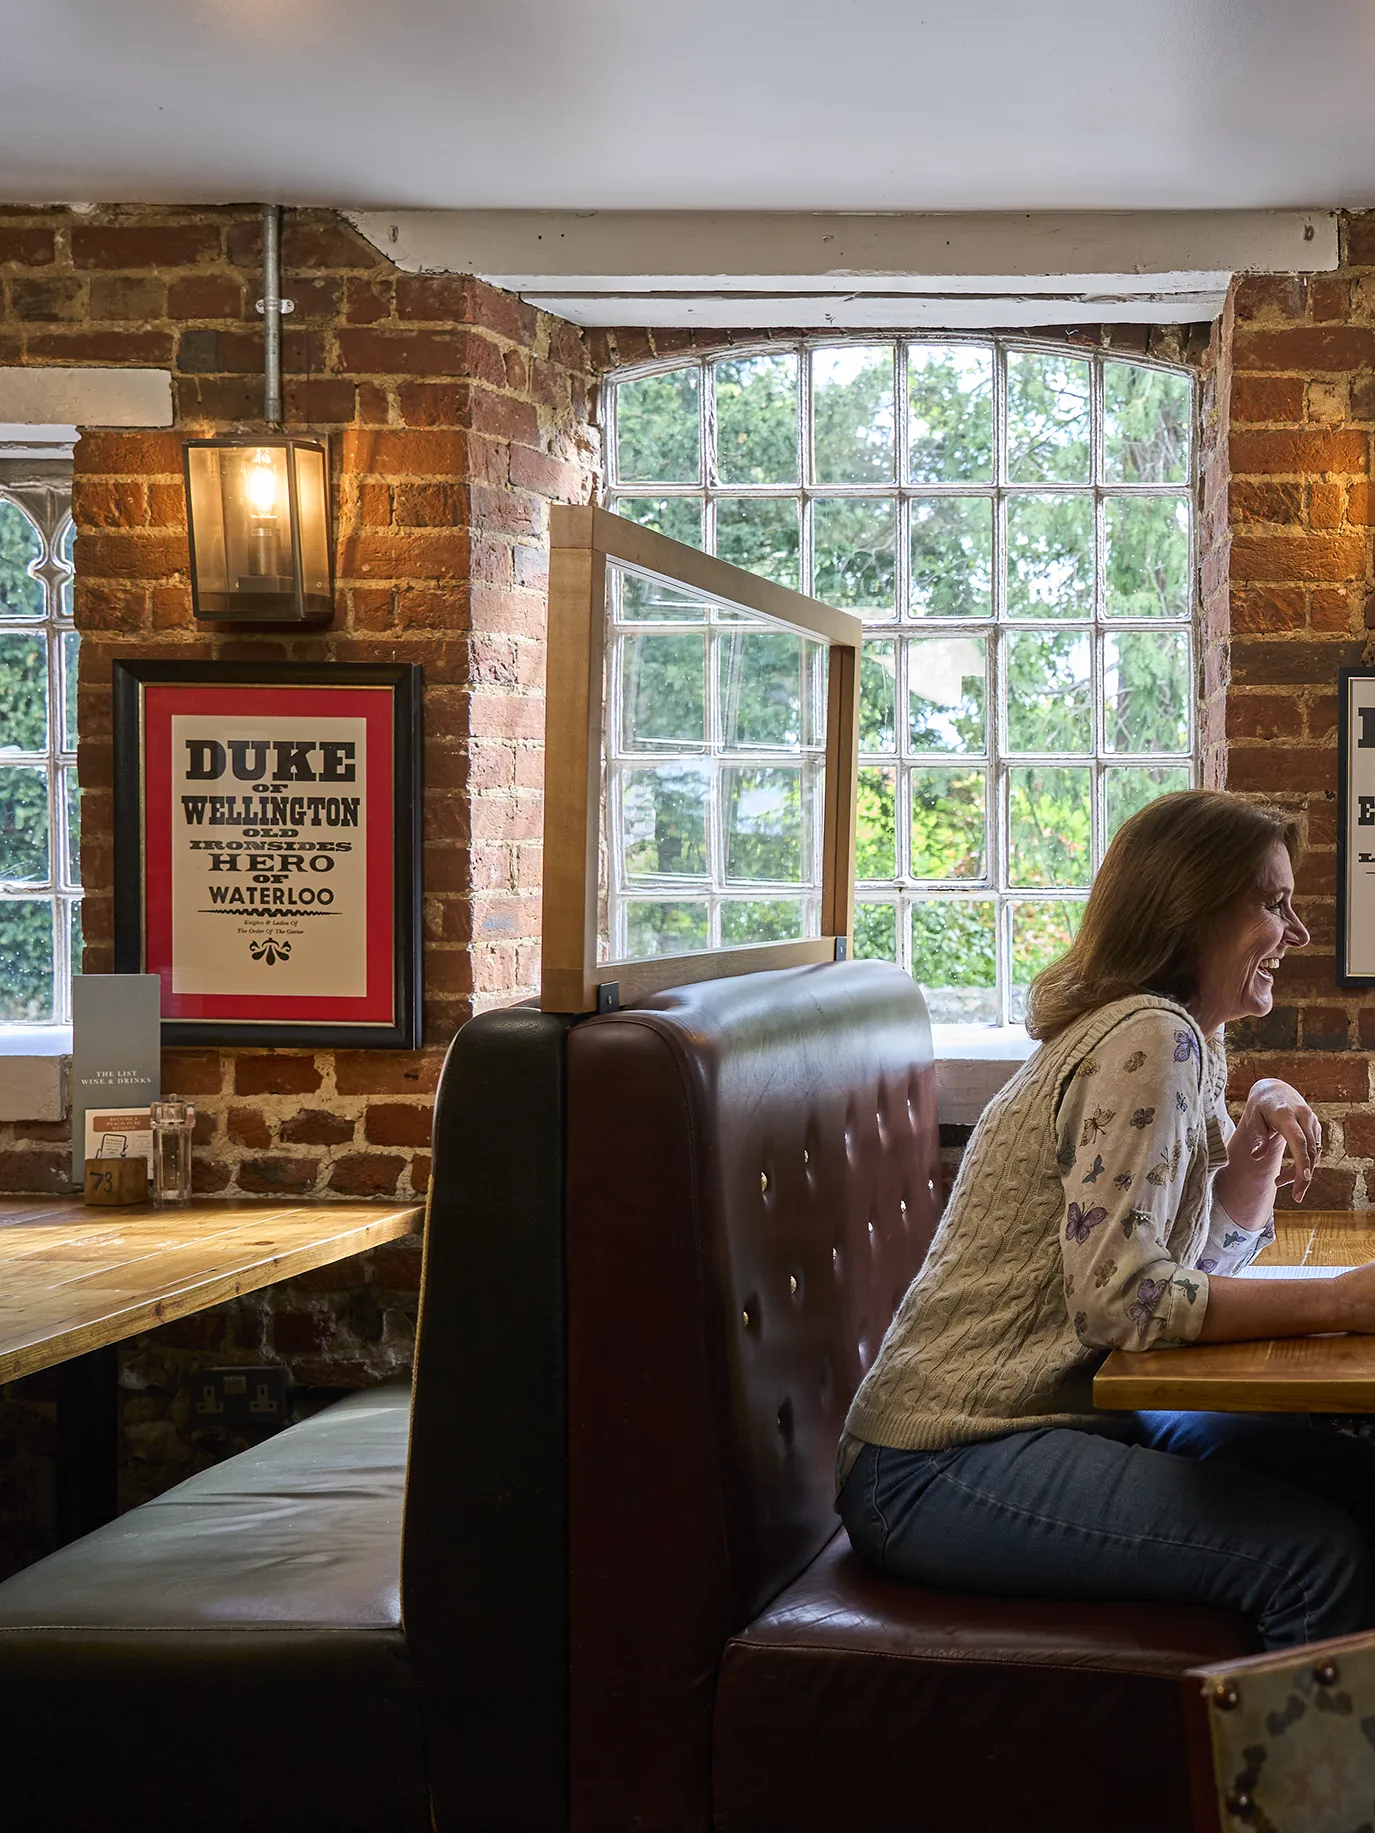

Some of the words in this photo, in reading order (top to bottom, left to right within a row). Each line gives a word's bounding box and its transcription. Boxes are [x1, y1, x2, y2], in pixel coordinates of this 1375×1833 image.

[185, 739, 356, 783] DUKE
[252, 783, 289, 793] OF
[181, 795, 361, 827] WELLINGTON
[242, 828, 299, 838] OLD
[189, 840, 353, 852] IRONSIDES
[208, 853, 335, 873] HERO
[252, 874, 289, 884] OF
[208, 886, 334, 906] WATERLOO
